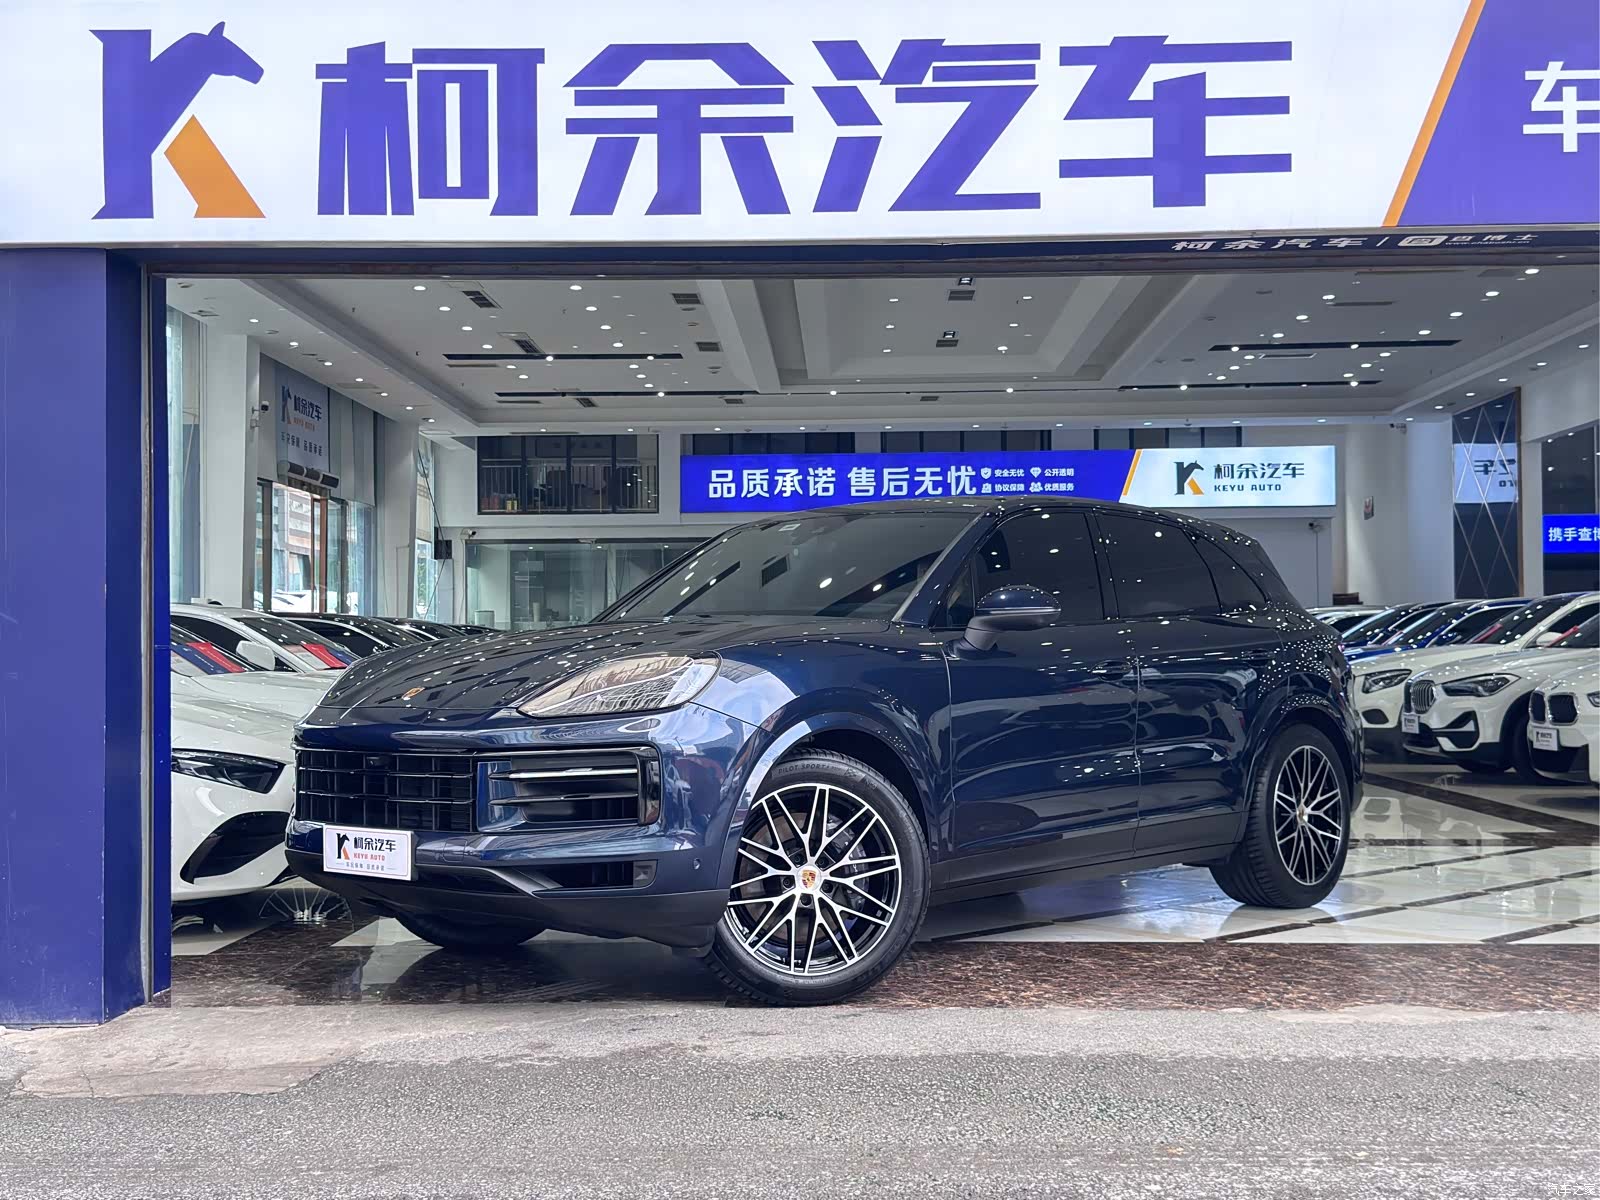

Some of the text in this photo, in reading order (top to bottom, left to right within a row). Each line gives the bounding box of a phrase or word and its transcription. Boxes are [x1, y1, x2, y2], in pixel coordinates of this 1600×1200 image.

[1523, 61, 1600, 152] 车
[315, 36, 1293, 216] 柯余汽车
[1171, 238, 1368, 251] 柯余汽车
[994, 469, 1025, 478] 安全无忧
[1044, 468, 1075, 477] 公开透明
[1213, 463, 1305, 479] 柯余汽车
[708, 465, 977, 498] 品质承诺 售后无忧
[1214, 484, 1244, 492] KEYU
[353, 836, 397, 852] 柯余汽车
